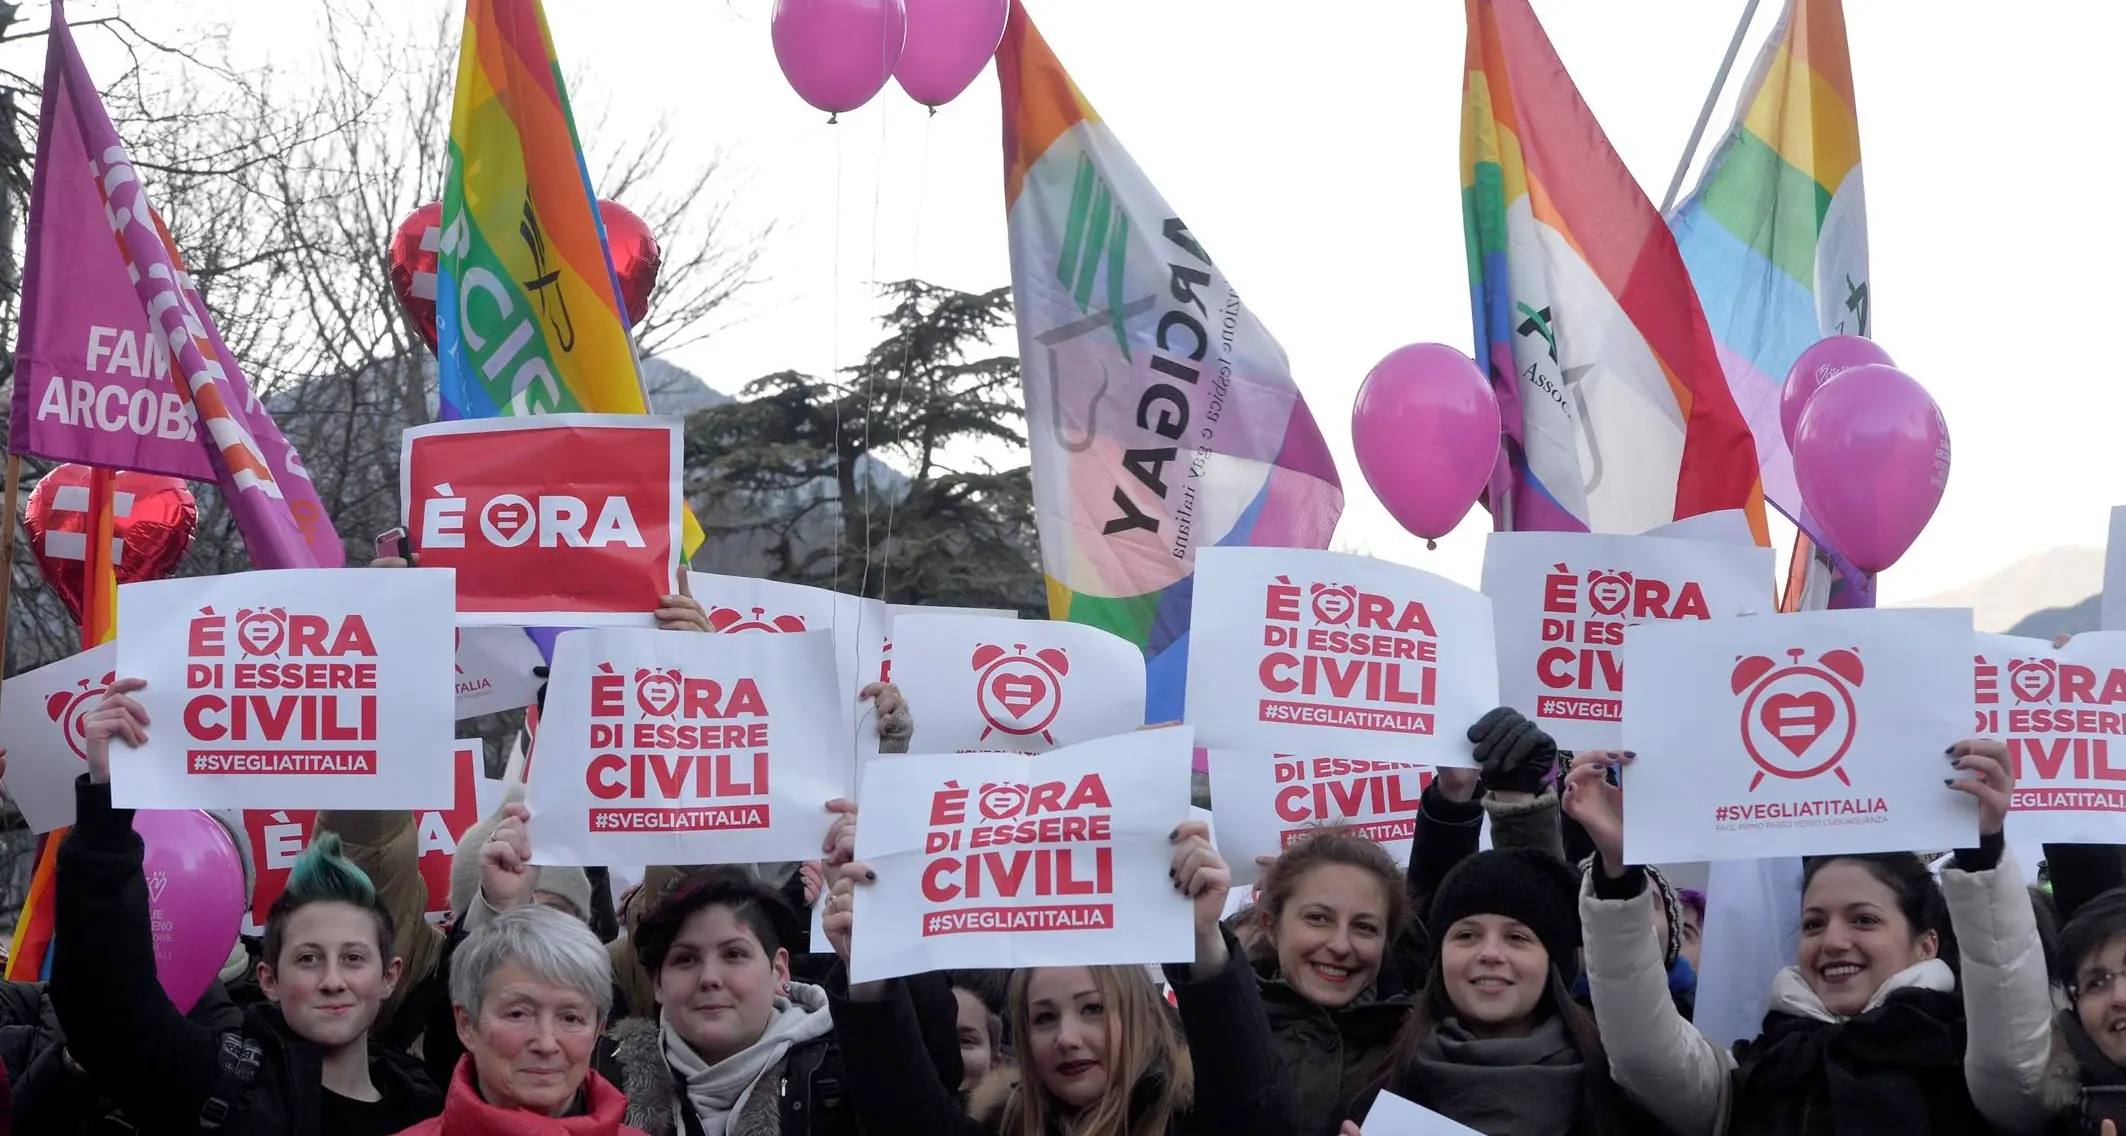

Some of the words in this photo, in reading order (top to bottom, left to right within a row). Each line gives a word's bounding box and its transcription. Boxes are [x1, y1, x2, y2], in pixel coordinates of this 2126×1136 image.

[86, 325, 172, 383] FAM
[37, 376, 197, 442] ARCOB
[1523, 362, 1569, 415] Assoc
[421, 482, 467, 548] È
[1266, 575, 1301, 621] È
[1544, 562, 1578, 613] È
[188, 605, 226, 657] È
[1264, 625, 1298, 648] DI
[1307, 629, 1437, 663] ESSERE
[1541, 618, 1575, 642] DI
[187, 663, 223, 689] DI
[234, 663, 376, 689] ESSERE
[455, 678, 491, 694] TALIA
[591, 662, 625, 717] È
[1258, 652, 1437, 706] CIVILI
[1536, 647, 1624, 692] CIV
[1974, 655, 1999, 704] È
[183, 694, 376, 741] CIVILI
[590, 723, 623, 748] DI
[633, 723, 768, 750] ESSERE
[1265, 704, 1426, 731] #SVEGLIATITALIA
[2009, 709, 2126, 735] ESSER
[193, 755, 368, 771] #SVEGLIATITALIA
[585, 753, 769, 799] CIVILI
[1275, 760, 1305, 783] DI
[2006, 738, 2126, 781] IVIL
[595, 809, 762, 828] #SVEGLIATITALIA
[929, 780, 969, 826] È
[1716, 798, 1888, 821] #SVEGLIATITALIA
[2010, 792, 2126, 809] EGLIATITALI
[264, 810, 303, 870] È
[926, 829, 961, 854] DI
[970, 815, 1111, 848] ESSERE
[921, 847, 1113, 902] CIVILI
[928, 908, 1105, 932] #SVEGLIATITALIA
